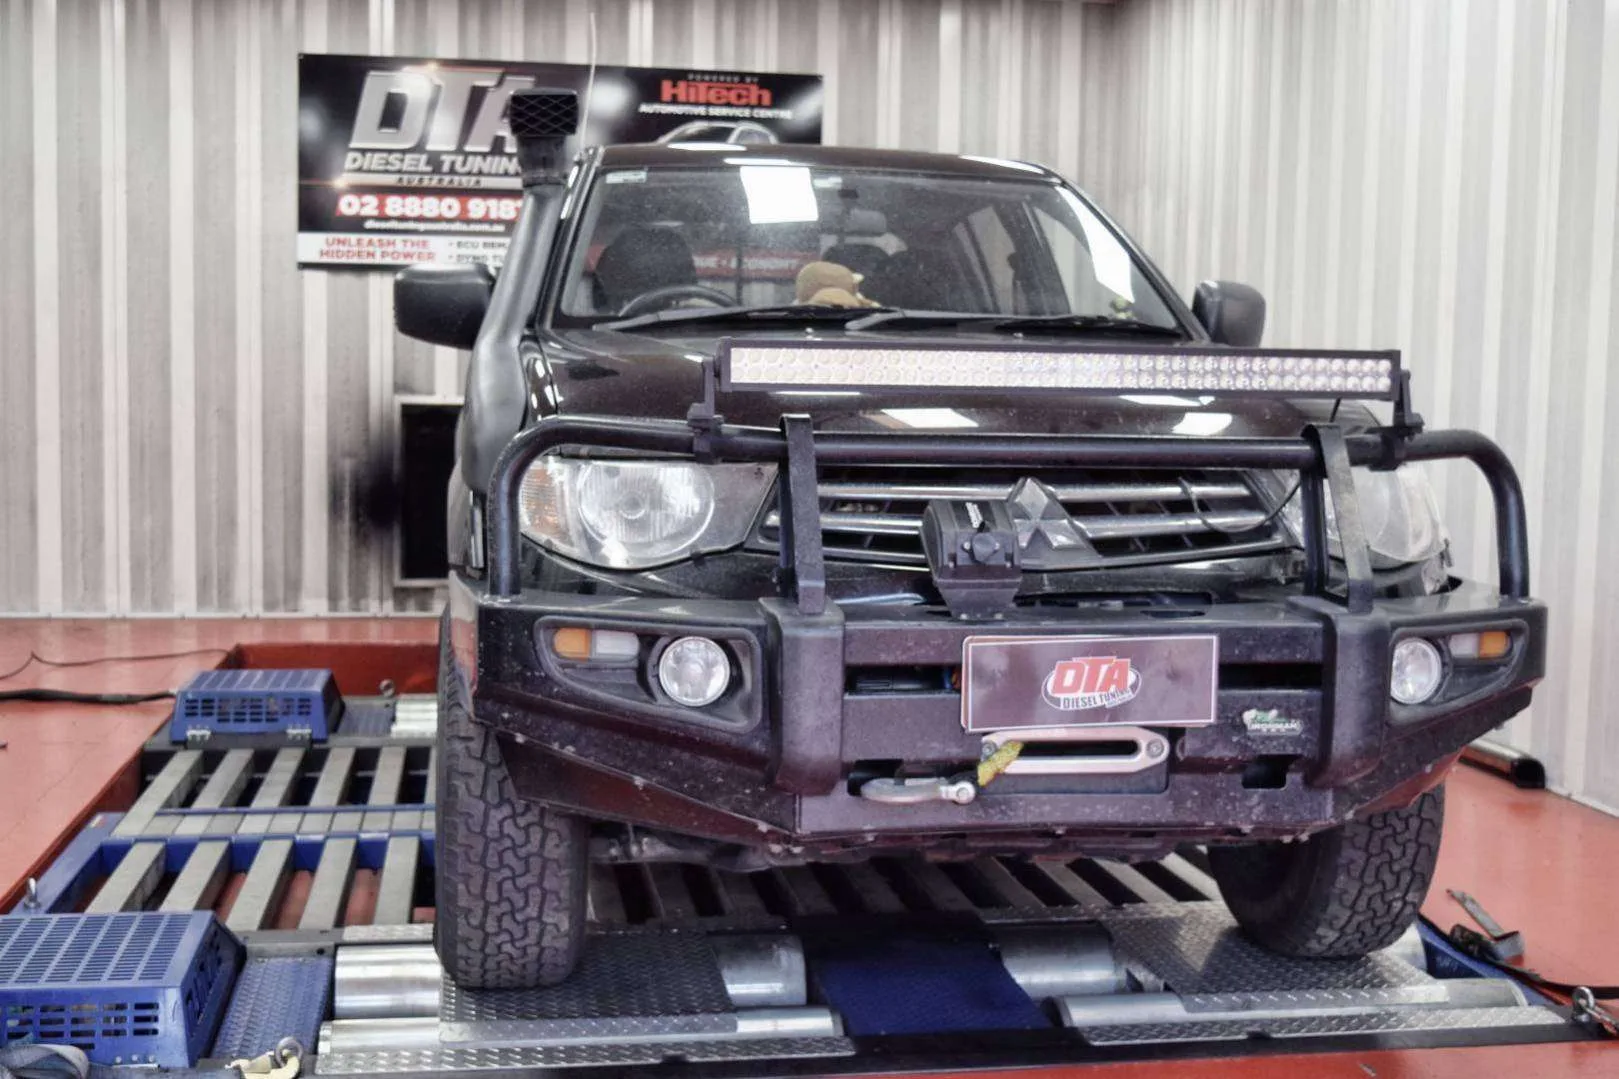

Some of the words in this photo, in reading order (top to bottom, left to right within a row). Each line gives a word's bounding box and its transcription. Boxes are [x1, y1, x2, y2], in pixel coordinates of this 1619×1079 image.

[661, 80, 772, 106] HiTech
[349, 66, 535, 153] DTA
[638, 103, 706, 116] AUTOMOTIVE
[707, 106, 751, 117] SERVICE
[344, 152, 432, 172] DIESEL
[439, 154, 522, 174] TUNIN
[397, 176, 482, 188] AUSTRALIA
[338, 193, 379, 216] 02
[385, 194, 461, 218] 8880
[325, 236, 397, 249] UNLEASH
[401, 239, 430, 250] THE
[320, 248, 375, 260] HIDDEN
[380, 250, 436, 262] POWER
[1051, 656, 1130, 694] DTA
[1062, 694, 1098, 709] DIESEL
